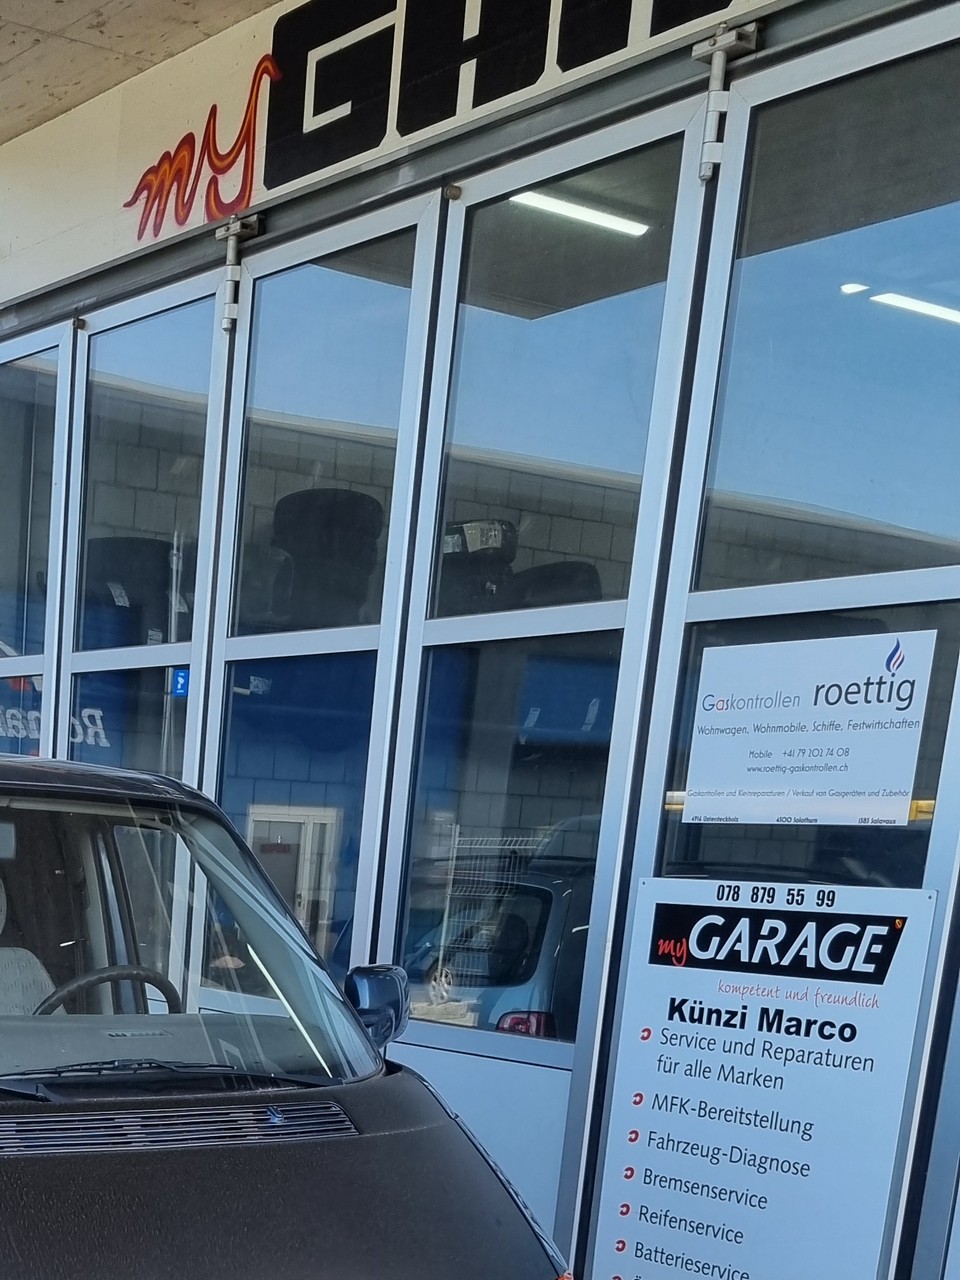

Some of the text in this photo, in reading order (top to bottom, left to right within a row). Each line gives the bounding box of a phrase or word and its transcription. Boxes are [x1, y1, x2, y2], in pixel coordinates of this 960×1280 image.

[123, 54, 282, 241] my
[702, 672, 916, 711] Gaskontrollen roettig
[847, 718, 920, 730] Festwirtschaften
[747, 763, 848, 774] www.roettig-gaskontrollen.ch
[748, 749, 773, 759] Mobile
[782, 749, 795, 758] +41
[796, 748, 806, 757] 79
[825, 748, 835, 757] 74
[837, 747, 850, 757] 08
[867, 789, 880, 797] und
[716, 884, 835, 907] 078 879 55 99
[657, 915, 889, 973] my GARAGE
[718, 979, 879, 1009] kompetent und freundlich
[667, 997, 858, 1043] Künzi Marco
[660, 1028, 875, 1073] Service und Reparaturen
[656, 1054, 784, 1090] für alle Marken
[651, 1093, 814, 1142] MFK-Bereitstellung
[647, 1130, 811, 1178] Fahrzeug-Diagnose
[643, 1168, 768, 1210] Bremsenservice
[638, 1204, 744, 1245] Reifenservice
